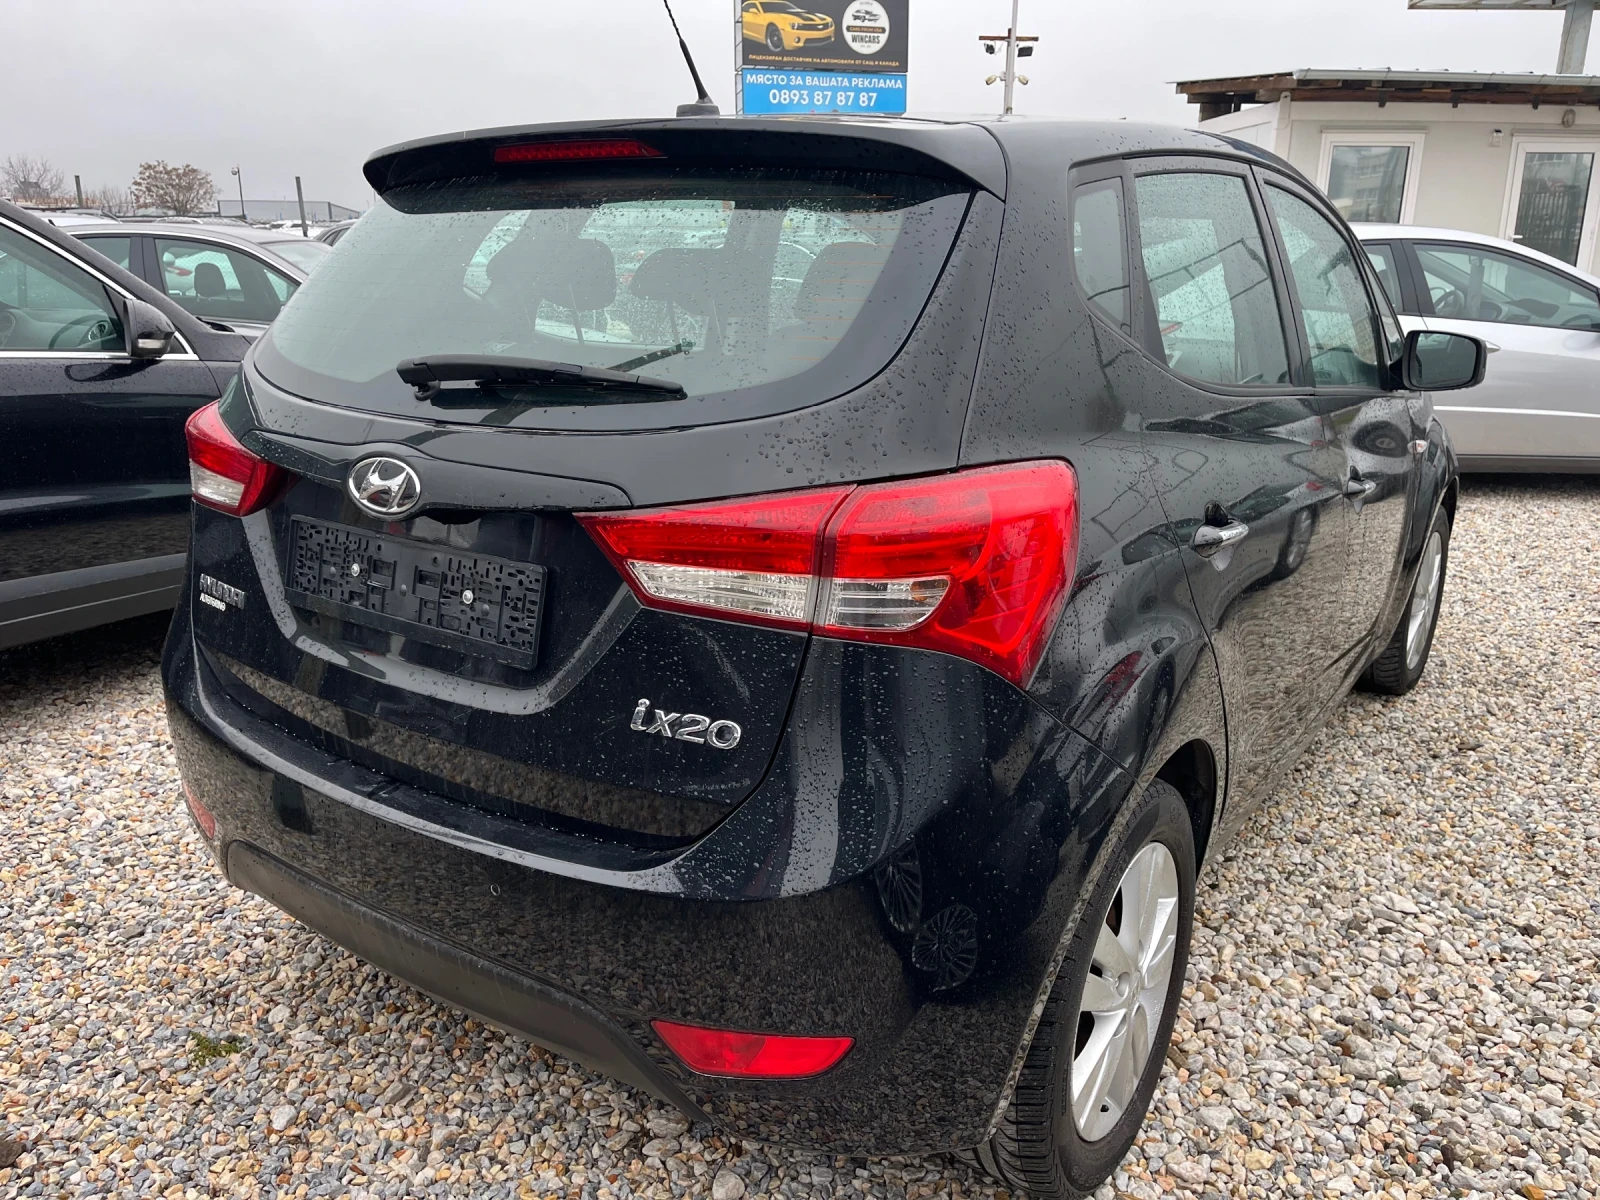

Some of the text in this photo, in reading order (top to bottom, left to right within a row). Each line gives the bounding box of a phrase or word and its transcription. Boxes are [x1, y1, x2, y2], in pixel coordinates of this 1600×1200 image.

[851, 34, 881, 44] WINCARS
[746, 73, 903, 89] МЯСТО ЗА ВАШАТА РЕКЛАМА
[769, 89, 878, 107] 0893 87 87 87
[630, 698, 741, 750] ix20
